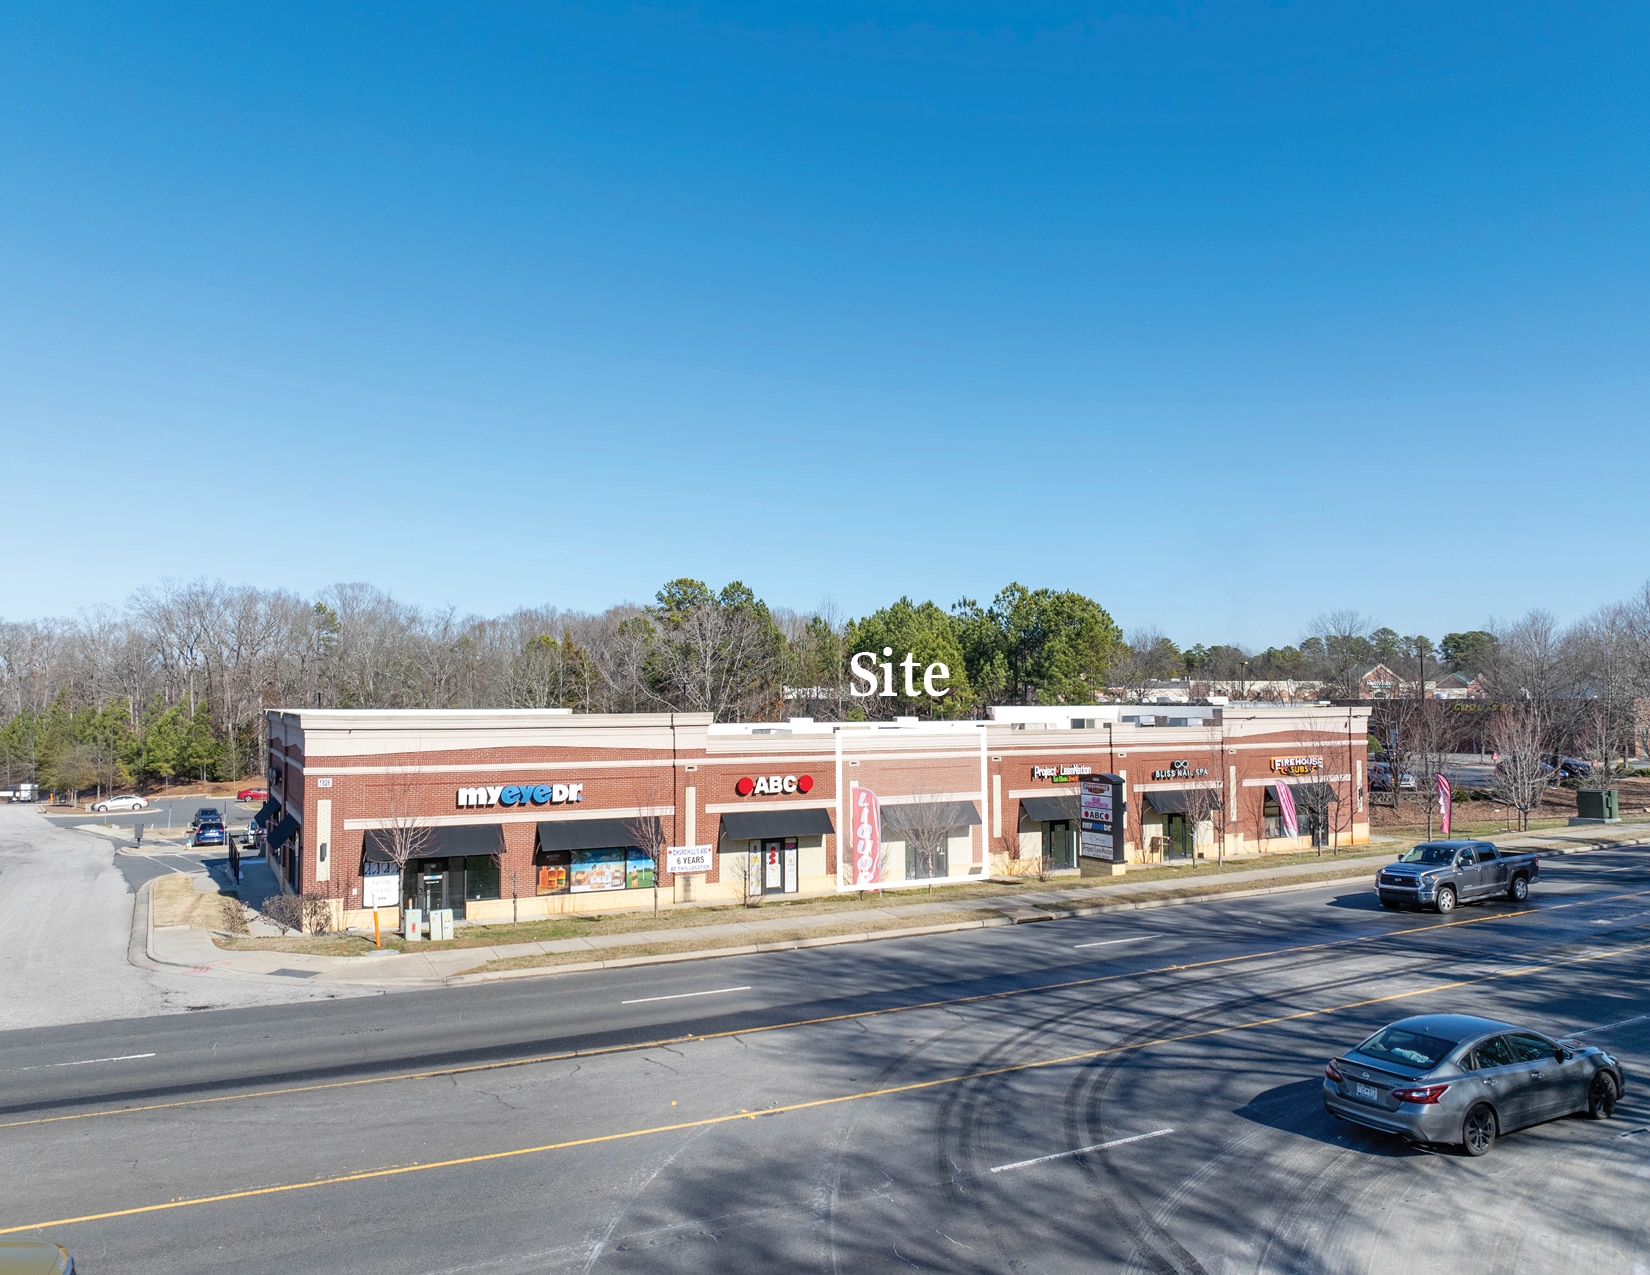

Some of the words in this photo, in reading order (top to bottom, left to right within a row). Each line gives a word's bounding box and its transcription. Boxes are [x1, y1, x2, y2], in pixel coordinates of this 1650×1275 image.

[1275, 757, 1323, 770] FIREHOUSE
[1034, 765, 1057, 779] Project
[1155, 769, 1175, 778] BLISS
[1177, 769, 1194, 777] NAIL
[1195, 768, 1208, 776] SPA
[1290, 765, 1309, 773] SUBS
[754, 775, 797, 794] ABC
[1090, 811, 1104, 820] ABC
[676, 857, 681, 865] 6
[683, 856, 705, 865] YEARS
